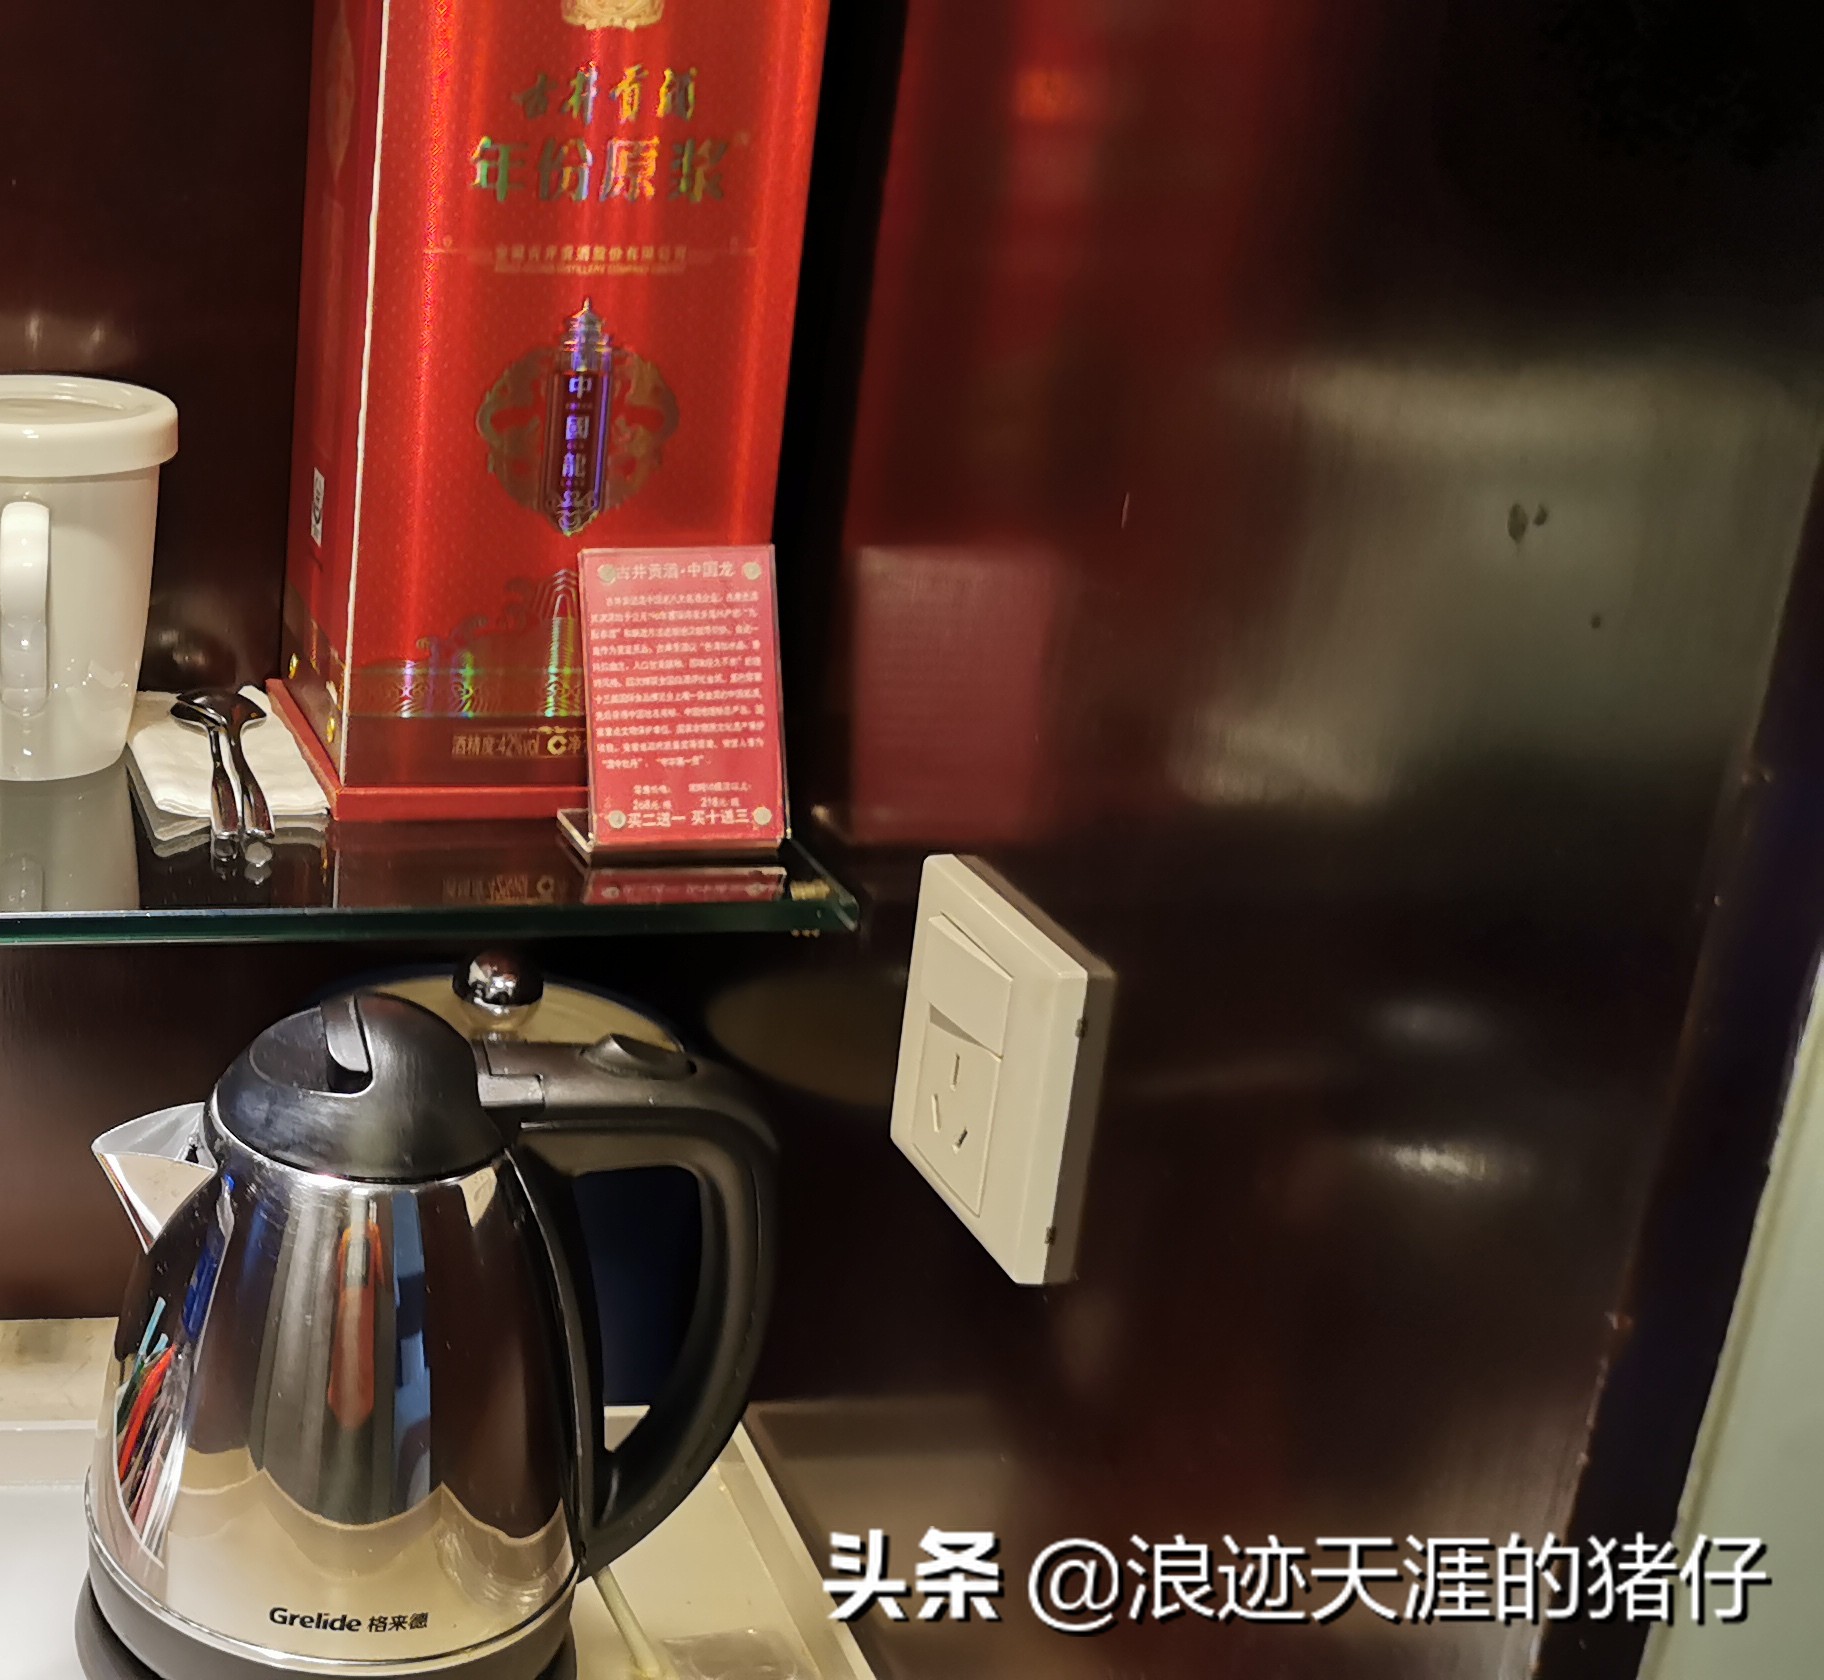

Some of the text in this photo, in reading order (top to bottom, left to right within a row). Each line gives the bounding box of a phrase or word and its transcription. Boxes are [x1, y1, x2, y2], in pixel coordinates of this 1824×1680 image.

[269, 1607, 429, 1633] Grelide 格来德
